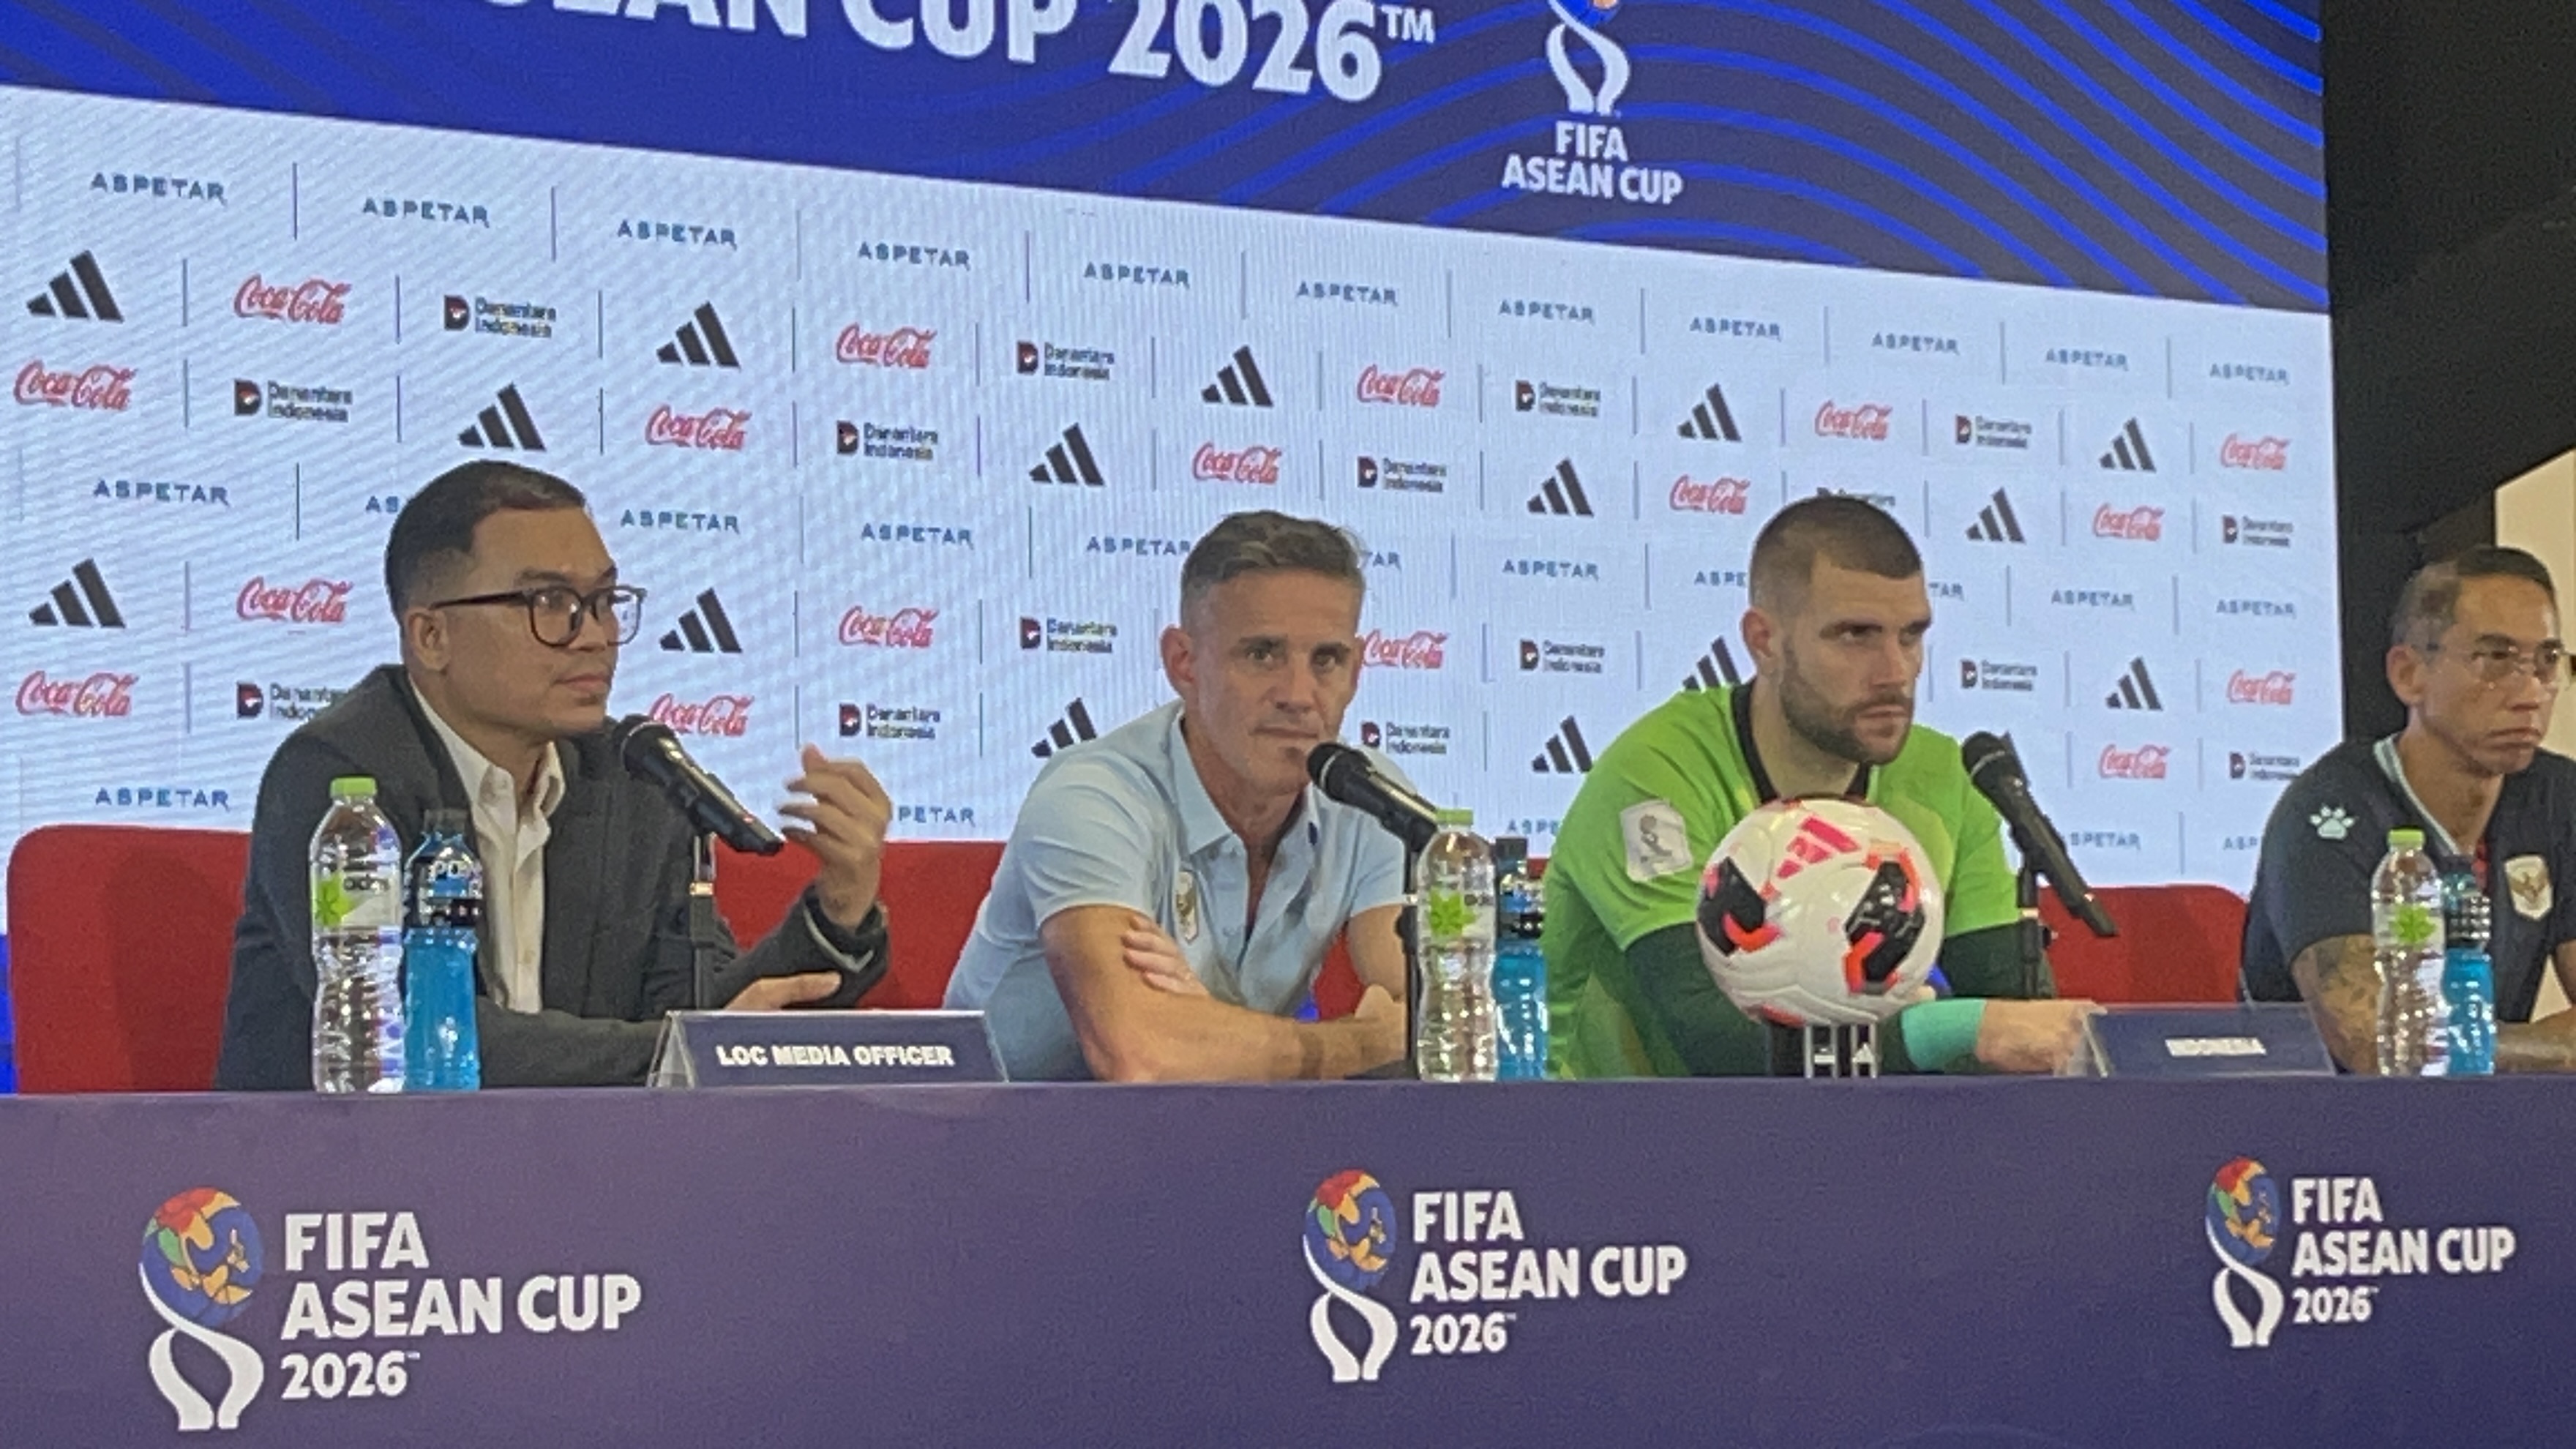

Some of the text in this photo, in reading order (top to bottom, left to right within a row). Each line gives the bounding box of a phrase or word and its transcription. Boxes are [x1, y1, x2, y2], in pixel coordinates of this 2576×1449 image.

[1556, 120, 1628, 162] FIFA
[91, 173, 225, 206] ASPETAR
[1502, 154, 1683, 204] ASEAN CUP
[362, 198, 489, 228] ASPETAR
[617, 220, 737, 250] ASPETAR
[858, 242, 970, 271] ASPETAR
[1084, 262, 1190, 289] ASPETAR
[1297, 282, 1398, 306] ASPETAR
[1499, 300, 1594, 323] ASPETAR
[1690, 317, 1781, 341] ASPETAR
[94, 479, 229, 506] ASPETAR
[621, 509, 739, 535] ASPETAR
[861, 523, 973, 550] ASPETAR
[1502, 559, 1599, 582] ASPETAR
[1694, 570, 1747, 587] ASPE
[95, 787, 229, 812] ASPETAR
[898, 805, 976, 828] PETAR
[1508, 819, 1557, 835] ASPE
[2070, 831, 2141, 850] SPETAR
[716, 1044, 956, 1067] LOC MEDIA OFFICER
[2292, 1177, 2384, 1224] FIFA
[1413, 1190, 1524, 1243] FIFA
[285, 1211, 430, 1272] FIFA
[2291, 1227, 2515, 1277] ASEAN CUP
[1409, 1246, 1687, 1303] ASEAN CUP
[280, 1273, 642, 1341] ASEAN CUP
